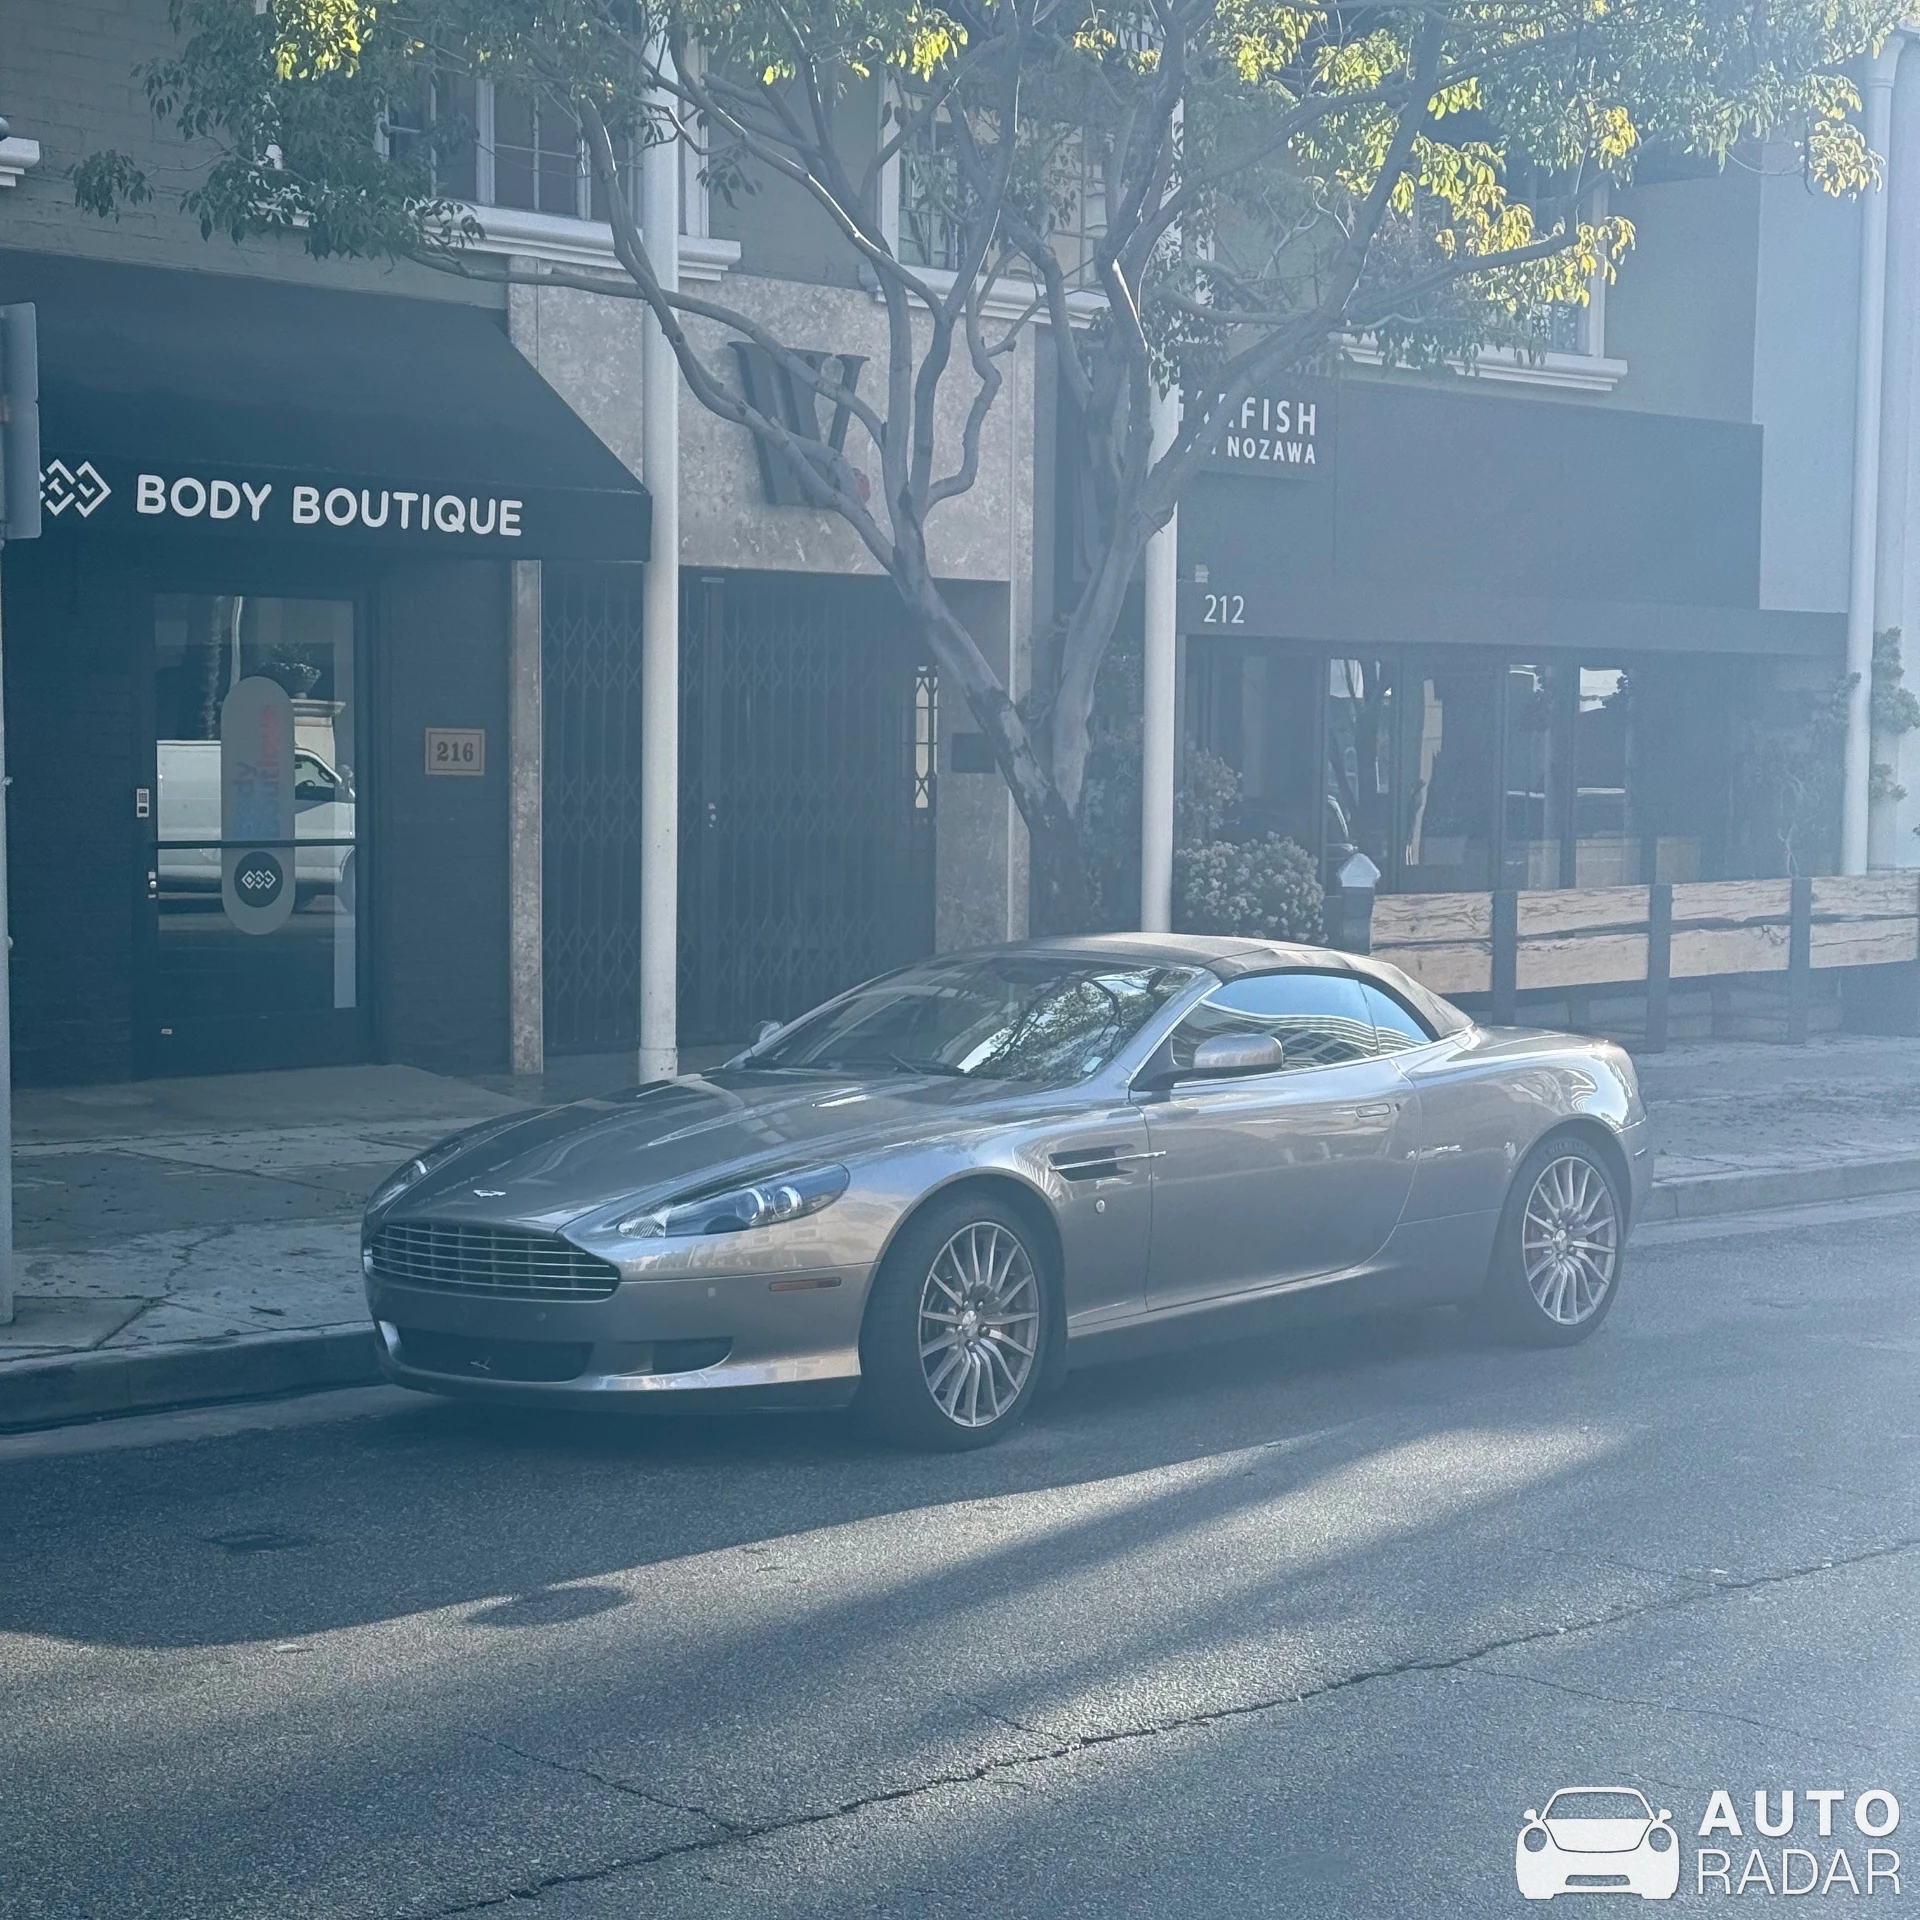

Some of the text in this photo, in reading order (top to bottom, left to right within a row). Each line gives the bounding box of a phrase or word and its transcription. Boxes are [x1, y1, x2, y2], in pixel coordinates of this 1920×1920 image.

[1227, 435, 1316, 465] NOZAWA
[136, 473, 523, 537] BODY BOUTIQUE
[1203, 594, 1245, 624] 212
[436, 741, 474, 762] 216
